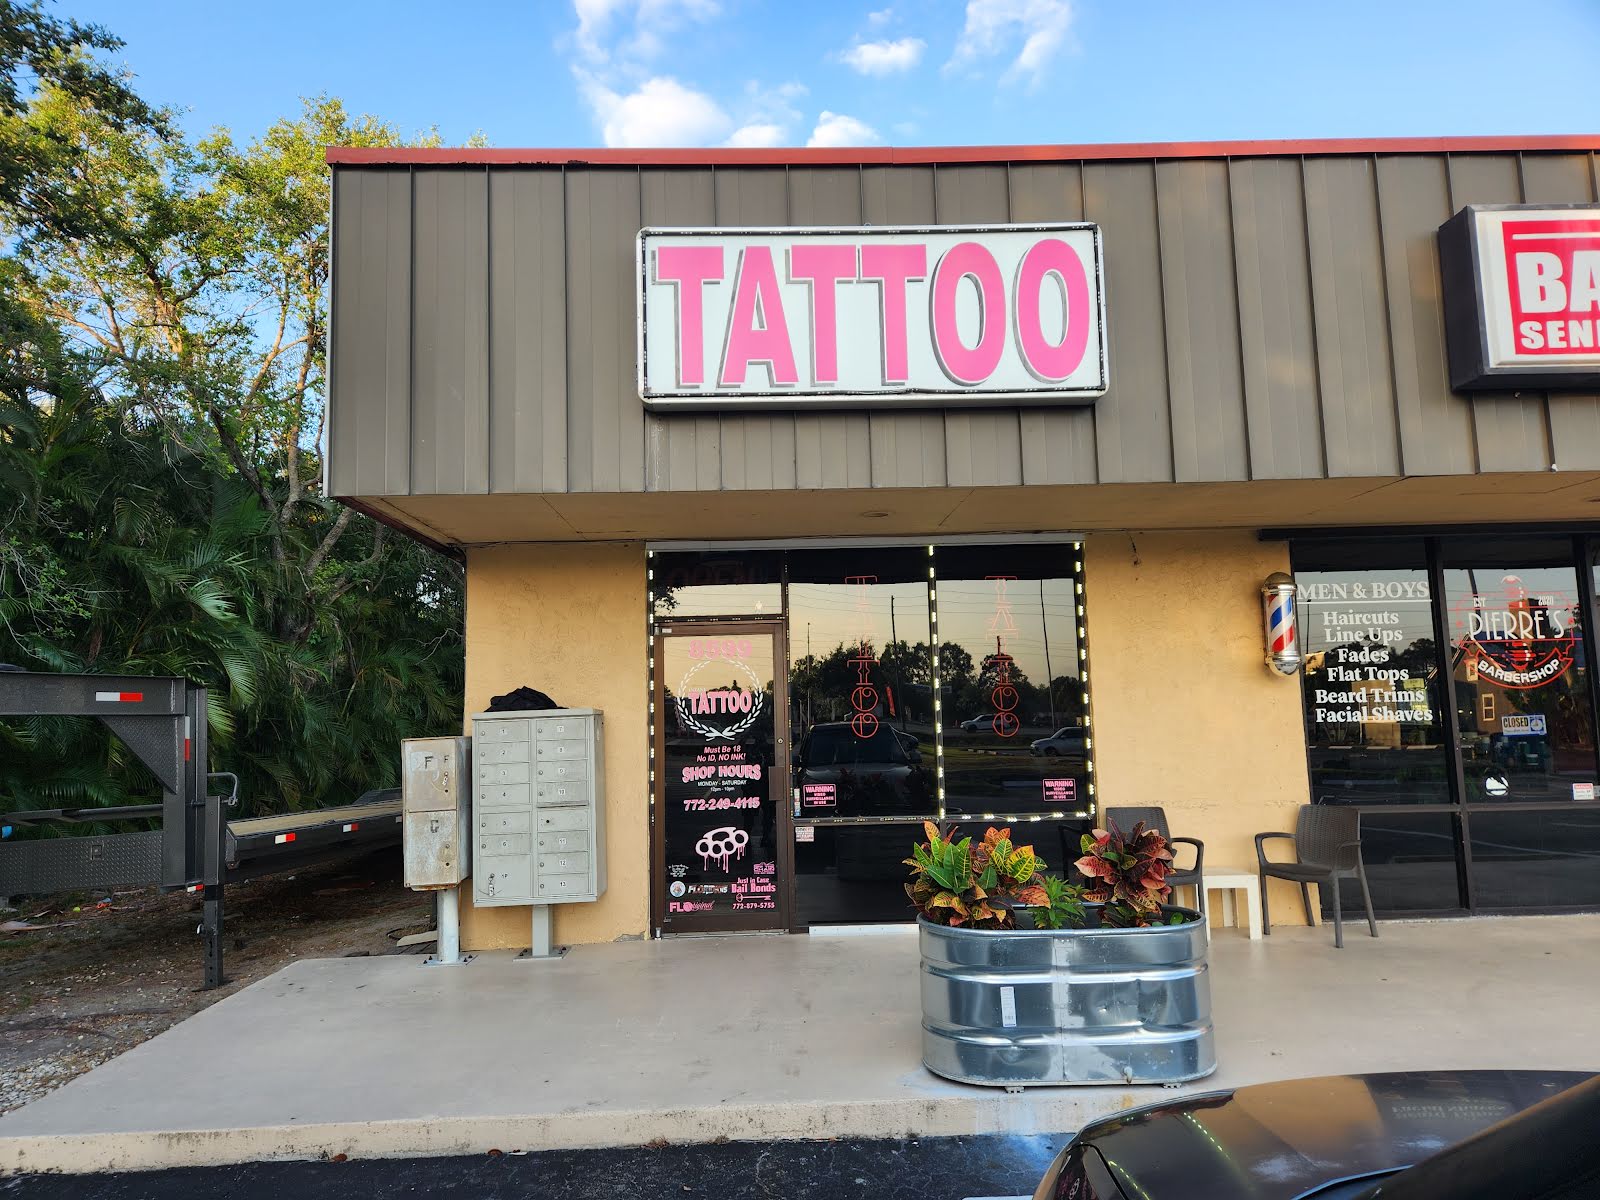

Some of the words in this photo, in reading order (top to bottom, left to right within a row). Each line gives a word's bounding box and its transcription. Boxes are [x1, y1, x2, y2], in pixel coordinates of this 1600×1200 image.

[653, 238, 1090, 387] TATTOO
[1297, 583, 1347, 600] MEN
[1352, 582, 1368, 599] &
[1371, 581, 1429, 598] BOYS
[1473, 597, 1486, 607] EST
[1322, 609, 1399, 625] Haircuts
[1468, 610, 1565, 640] PIERRE'S
[1324, 627, 1364, 642] Line
[1367, 627, 1403, 646] Ups
[1337, 647, 1389, 663] Fades
[1326, 666, 1361, 681] Flat
[1364, 666, 1409, 685] Tops
[1477, 658, 1560, 683] BARBERSHOP
[688, 689, 752, 715] TATTOO
[1315, 687, 1367, 703] Beard
[1370, 686, 1424, 702] Trims
[1315, 706, 1368, 722] Facial
[1371, 705, 1433, 721] Shaves
[1503, 716, 1529, 728] CLOSED
[703, 746, 720, 754] Must
[721, 745, 732, 753] Be
[708, 754, 717, 762] ID,
[718, 753, 730, 761] NO
[424, 755, 434, 769] F
[682, 765, 716, 783] SHOP
[718, 764, 761, 780] HOURS
[683, 797, 761, 811] 772-249-4115
[731, 883, 748, 893] Bail
[750, 882, 777, 893] Bonds
